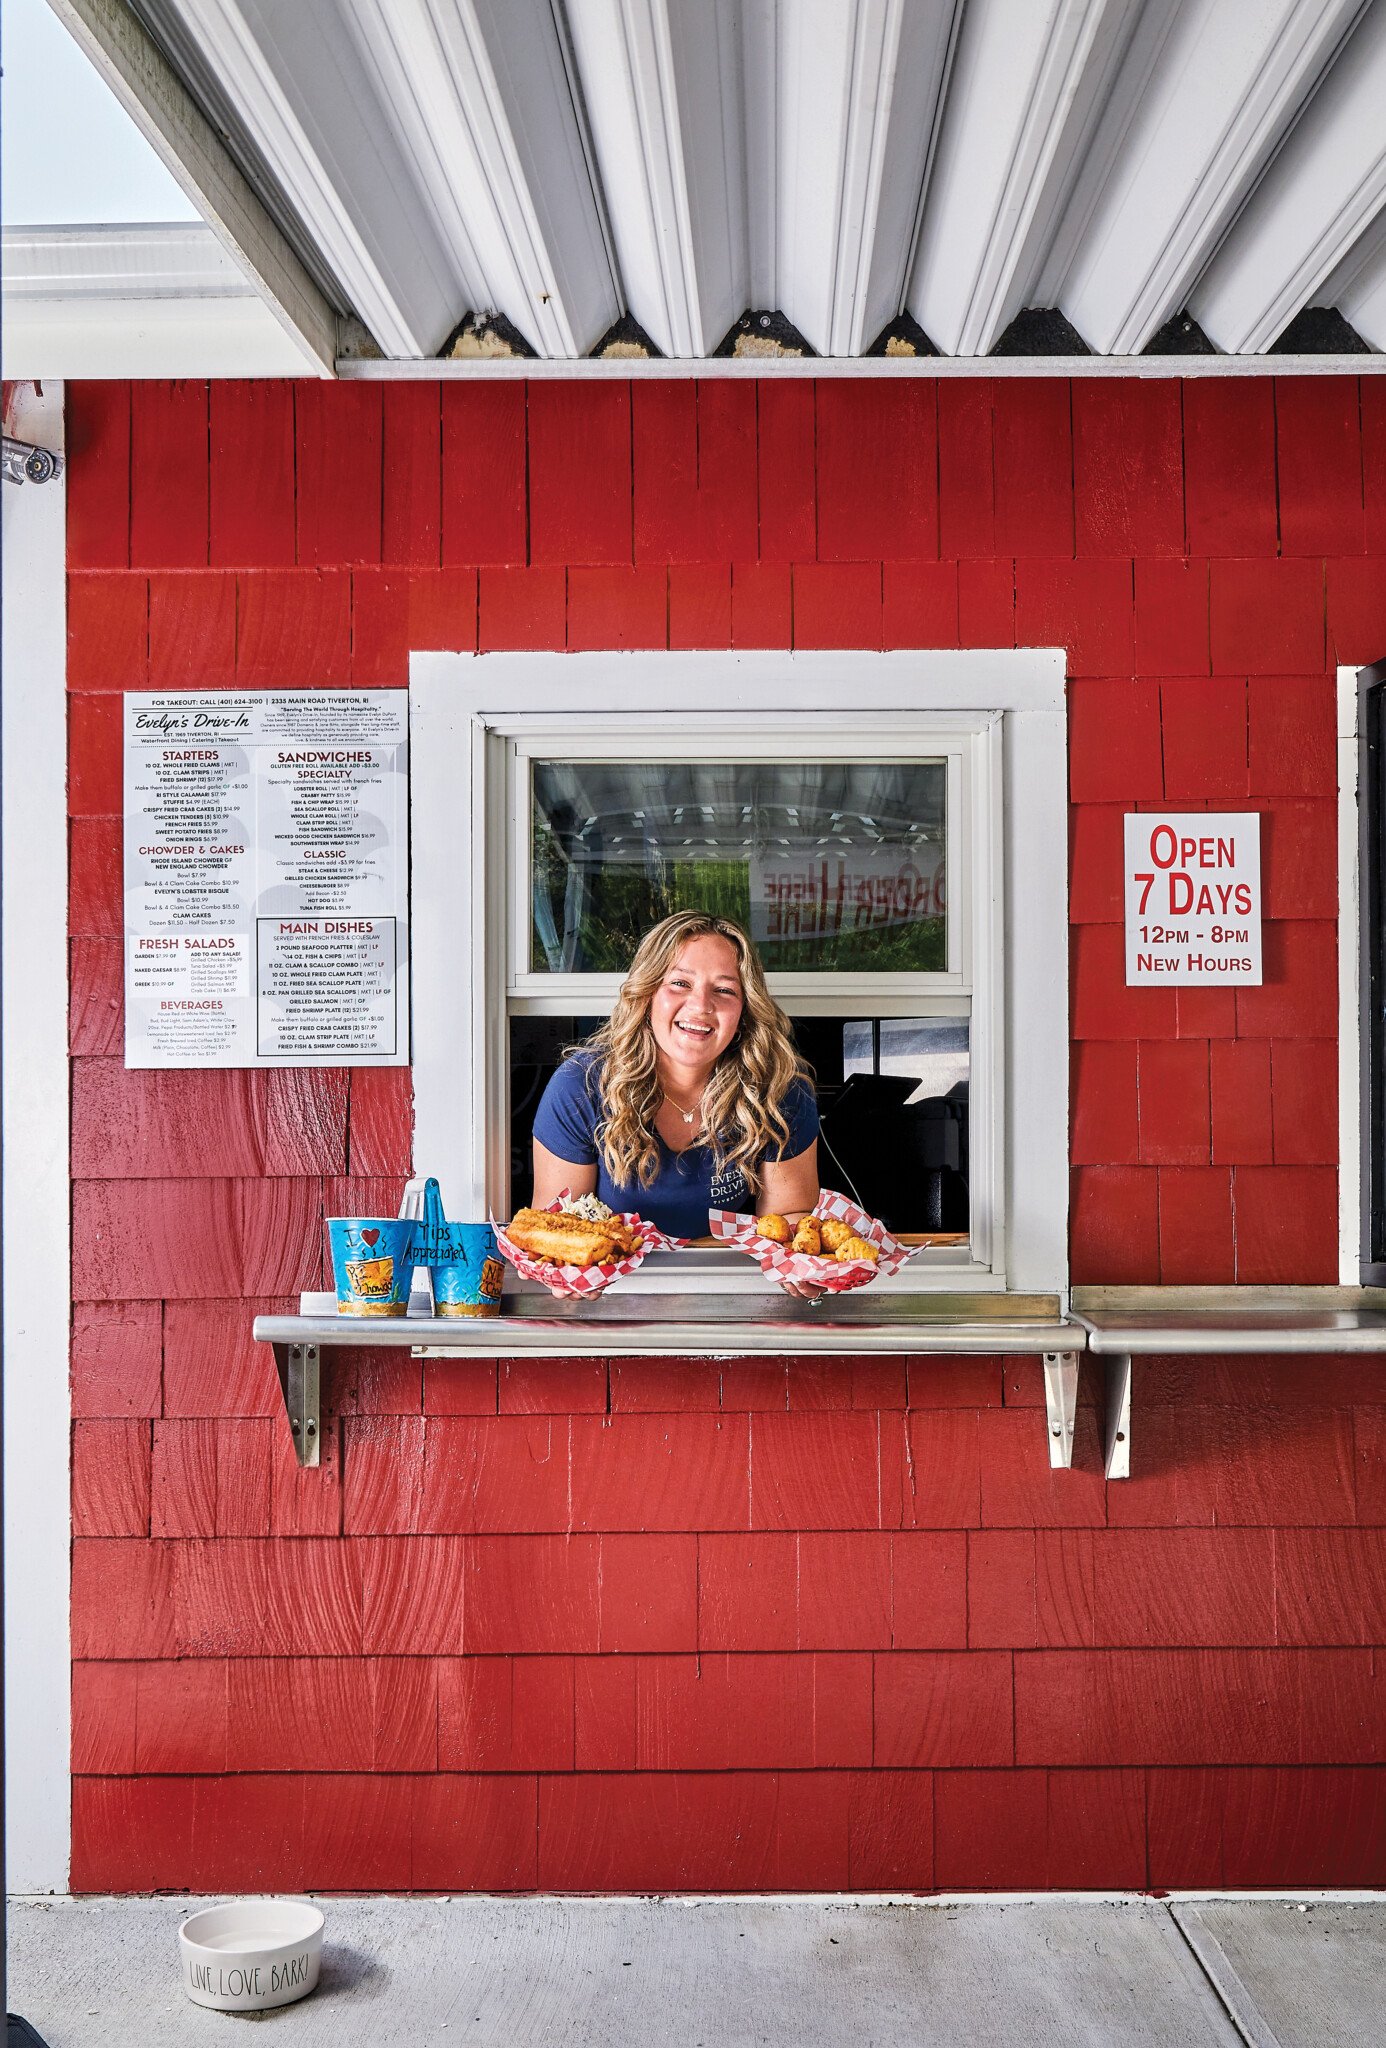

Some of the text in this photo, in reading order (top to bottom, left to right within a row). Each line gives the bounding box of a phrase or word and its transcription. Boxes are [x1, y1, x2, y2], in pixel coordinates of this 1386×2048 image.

[136, 714, 189, 733] Evelyn's
[193, 713, 250, 727] Drive-In
[163, 751, 219, 760] STARTERS
[278, 752, 372, 763] SANDWICHES
[298, 771, 352, 779] SPECIALTY
[139, 846, 244, 854] CHOWDER & CAKES
[1150, 825, 1235, 869] OPEN
[1135, 873, 1251, 915] 7 DAYS
[280, 922, 373, 933] MAIN DISHES
[140, 939, 235, 949] FRESH SALADS
[1138, 954, 1251, 971] NEW HOURS
[161, 1001, 223, 1009] BEVERAGES
[711, 1168, 743, 1185] EVELY
[344, 1229, 357, 1247] I
[419, 1223, 450, 1241] Tips
[405, 1243, 467, 1265] Appreciated
[189, 1954, 308, 1996] LIVE, LOVE, BARK!
